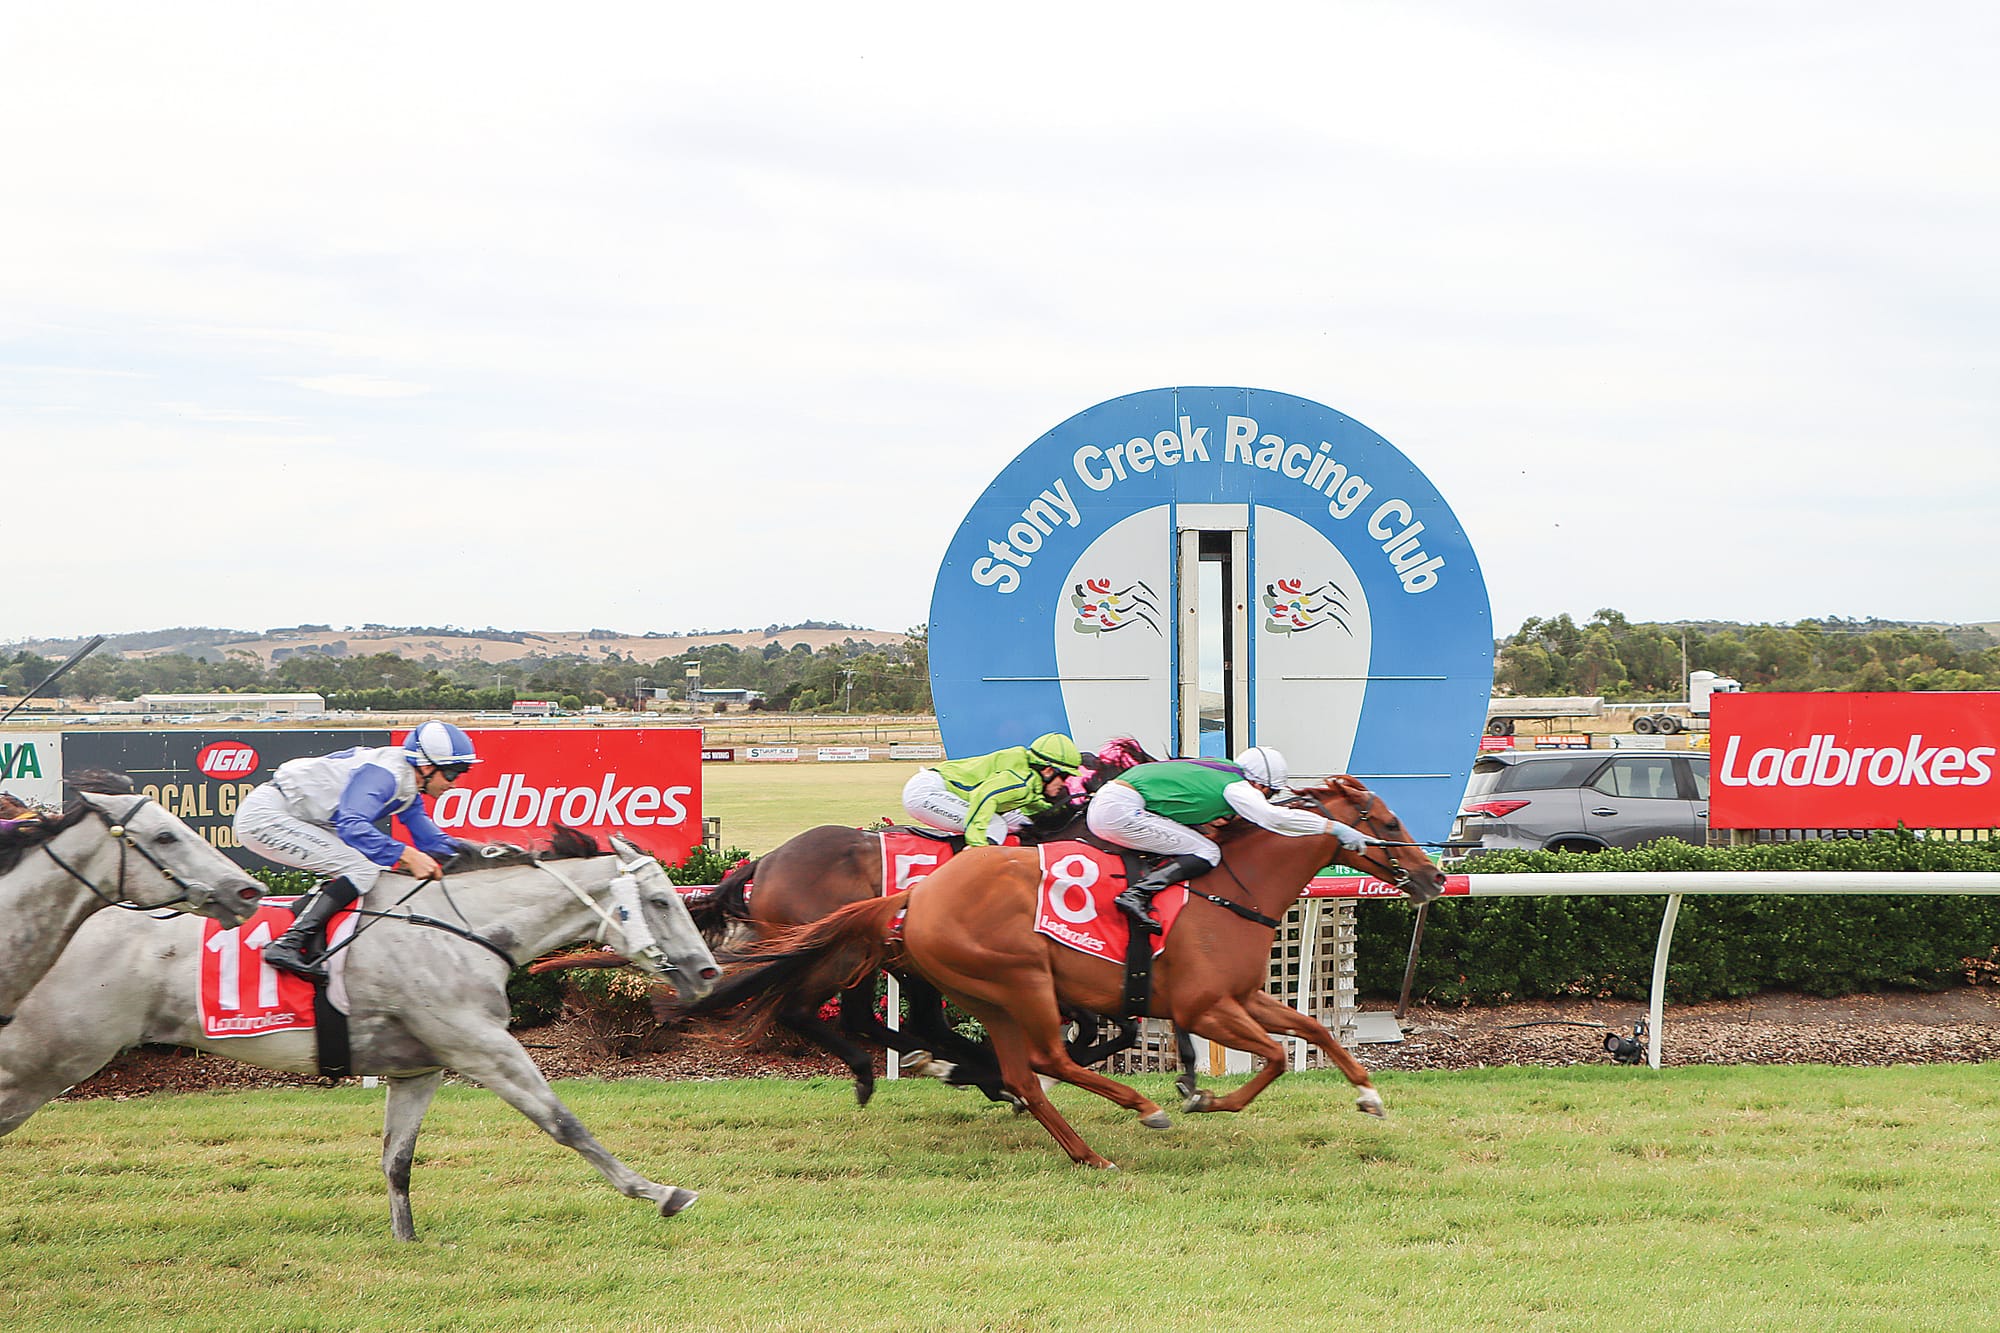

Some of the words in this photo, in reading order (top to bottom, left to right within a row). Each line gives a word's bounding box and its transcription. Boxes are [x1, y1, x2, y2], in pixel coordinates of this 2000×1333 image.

[971, 478, 1082, 595] Stony
[1073, 415, 1211, 492] Creek
[1224, 415, 1373, 520] Racing
[1367, 498, 1448, 594] Club
[202, 749, 254, 772] IGA
[1719, 734, 1996, 787] Ladbrokes
[432, 773, 692, 828] adbrokes
[1048, 853, 1100, 924] 8
[1040, 914, 1107, 952] Ladbrokes
[205, 920, 280, 1010] 11
